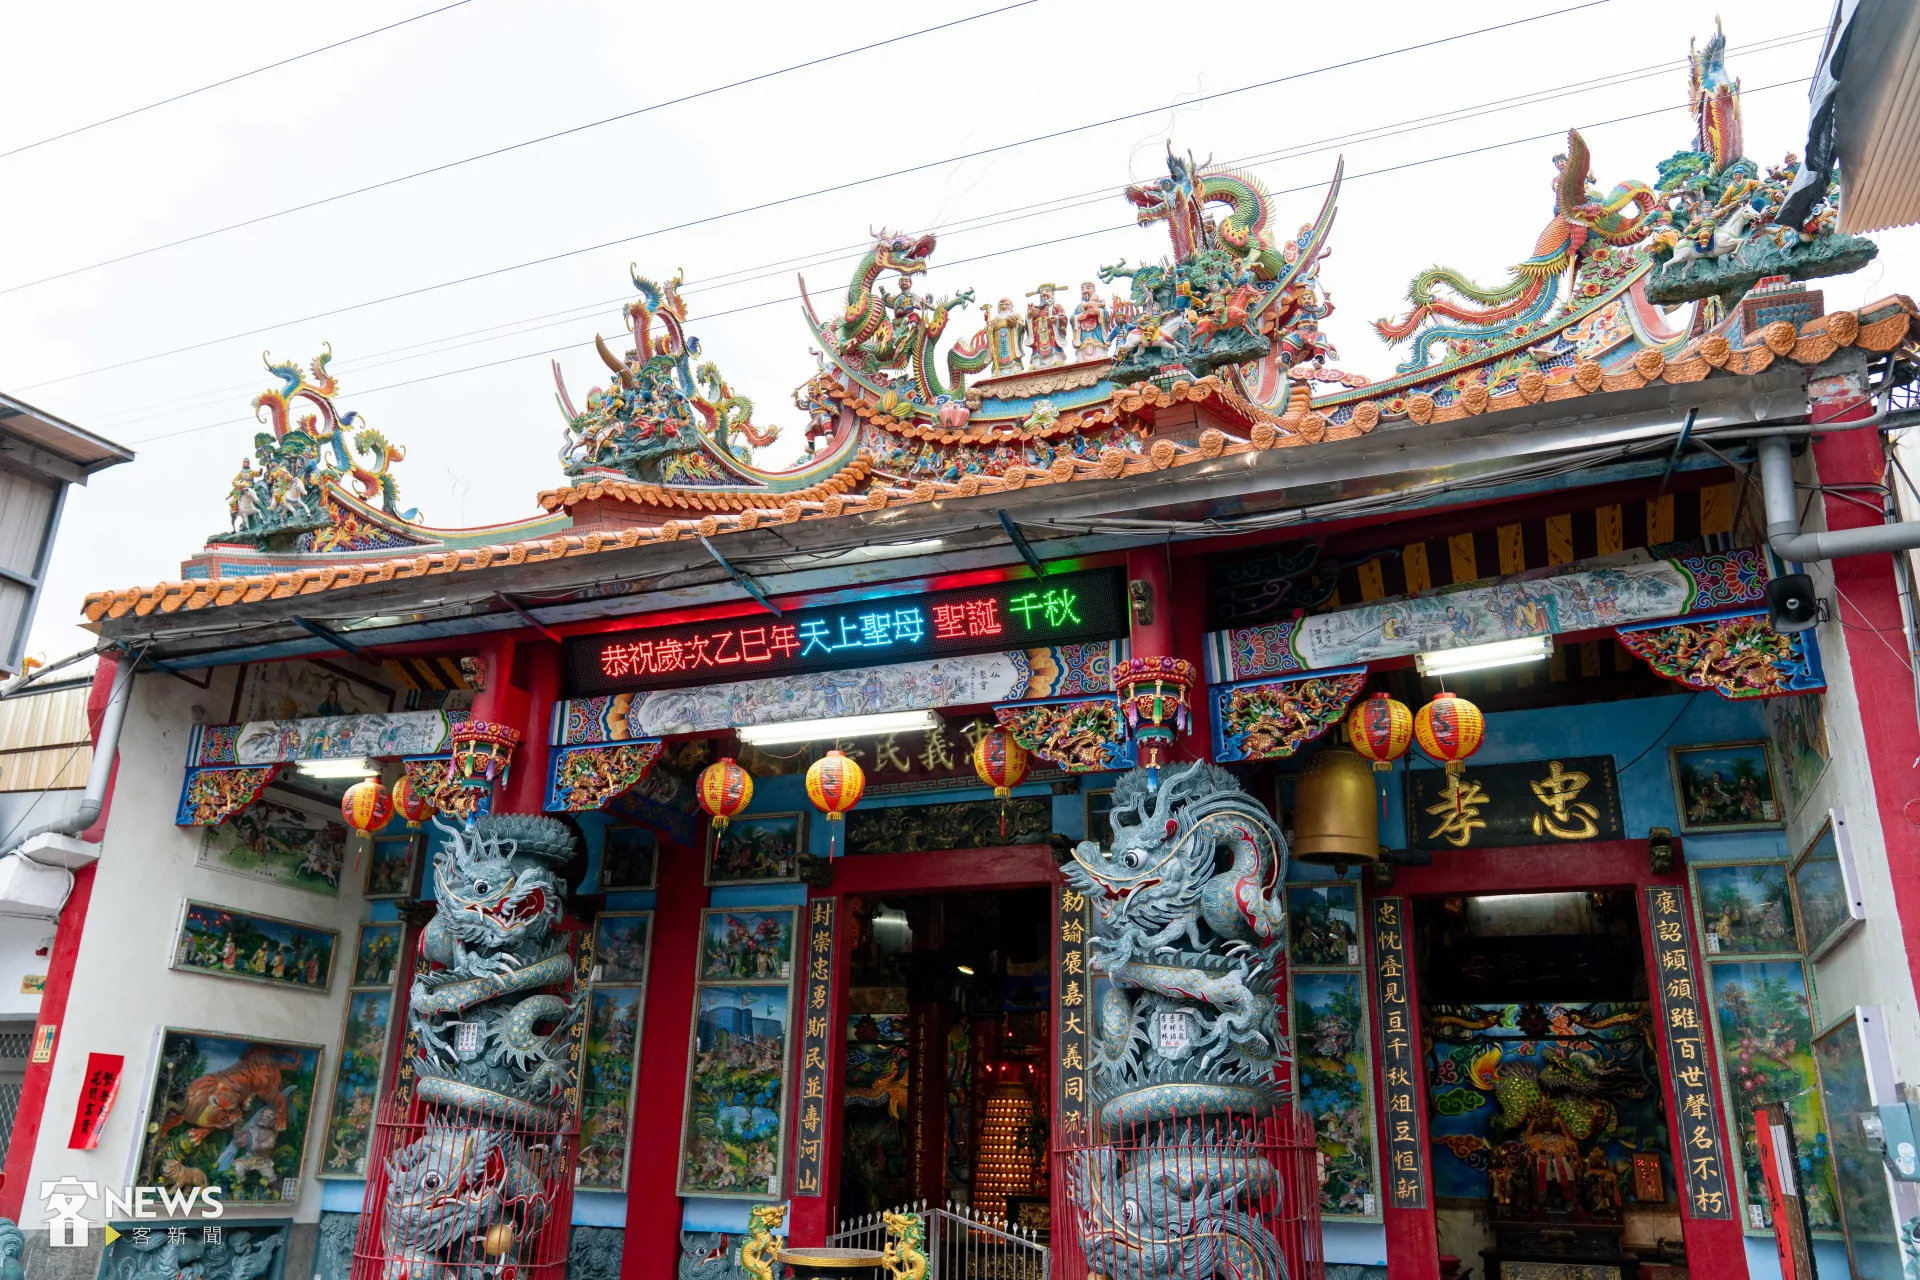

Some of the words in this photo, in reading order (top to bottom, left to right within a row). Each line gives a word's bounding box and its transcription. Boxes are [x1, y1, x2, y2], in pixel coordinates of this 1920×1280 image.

[601, 625, 800, 677] 恭祝歲次乙巳年
[799, 608, 924, 656] 天上聖母
[932, 598, 1002, 640] 聖誕
[1009, 588, 1081, 630] 千秋
[1060, 889, 1086, 1188] 勅諭褒嘉大義同流
